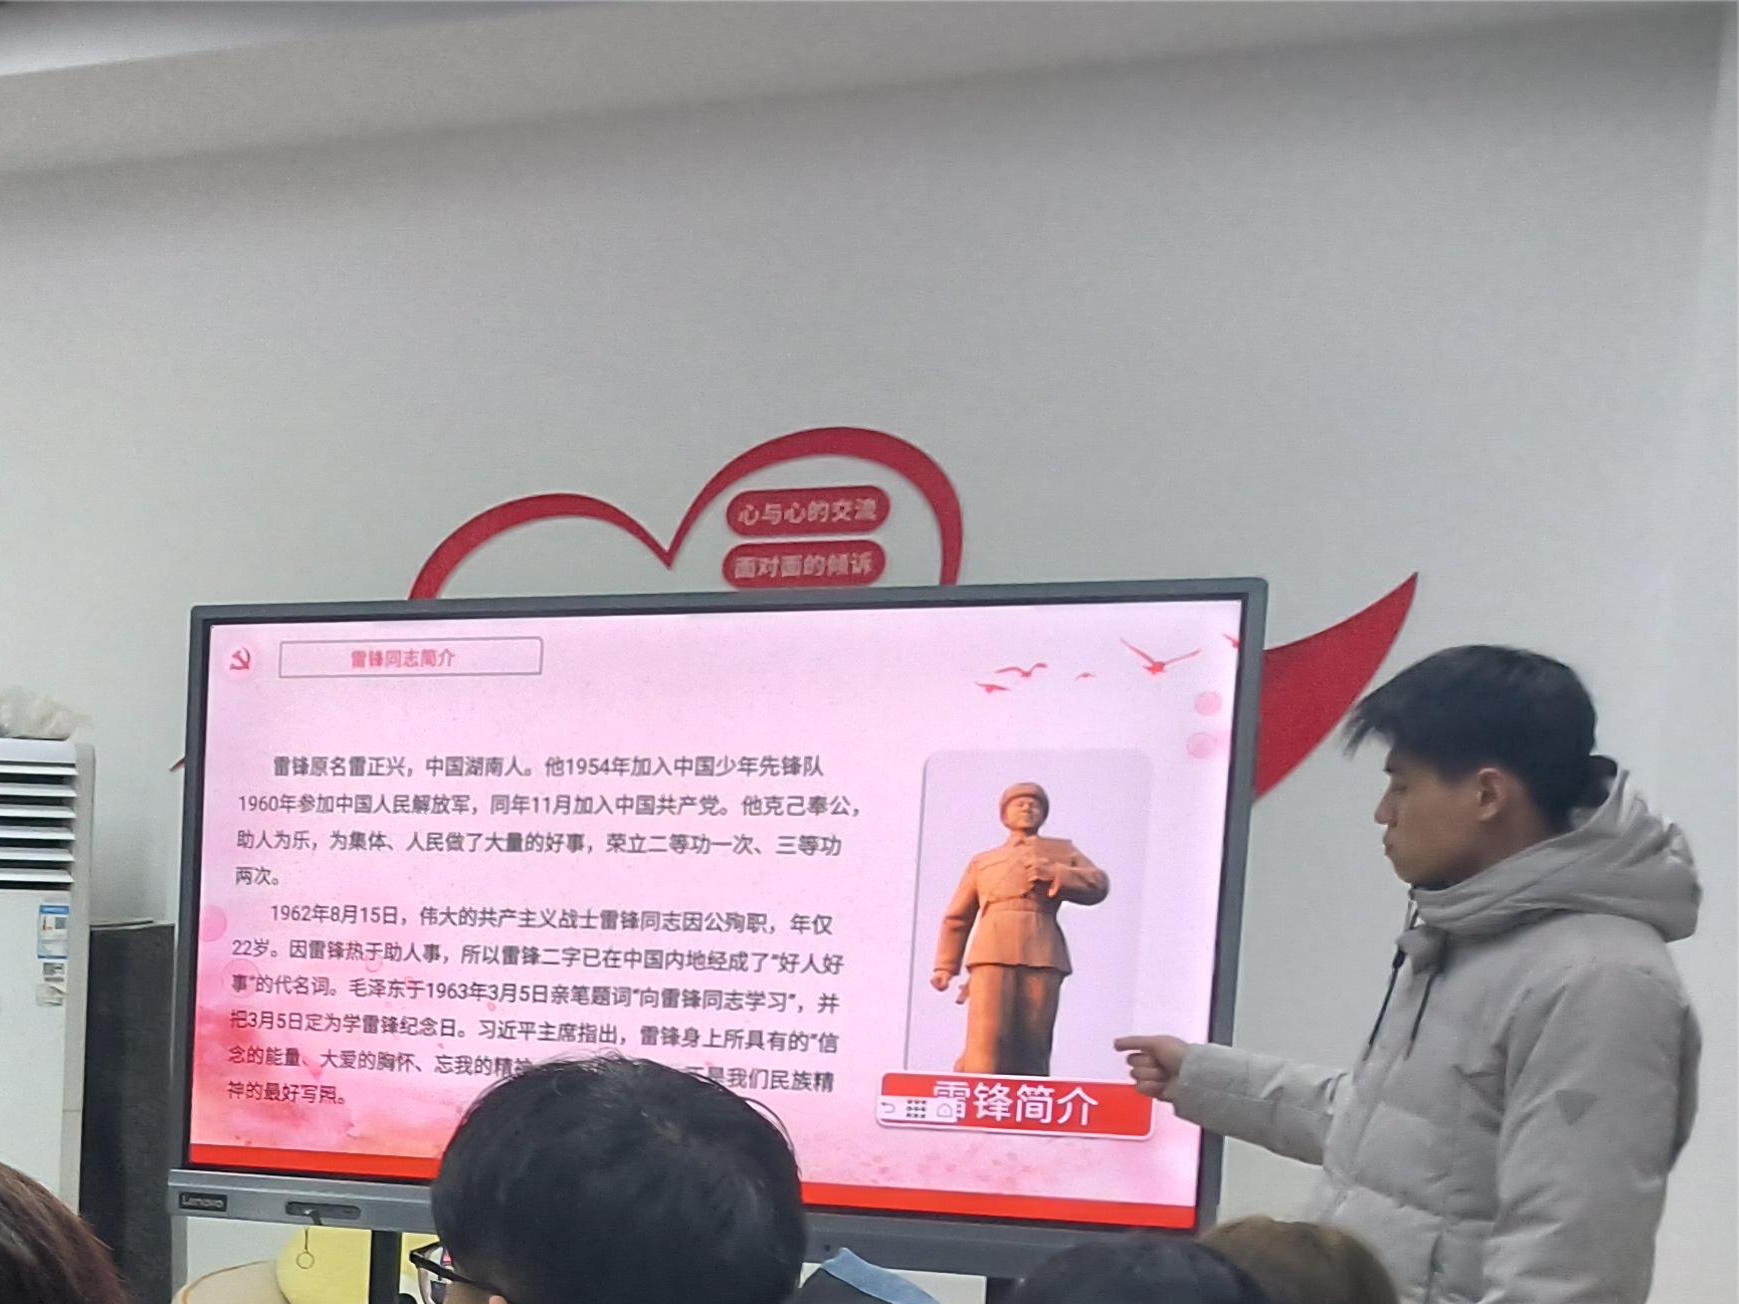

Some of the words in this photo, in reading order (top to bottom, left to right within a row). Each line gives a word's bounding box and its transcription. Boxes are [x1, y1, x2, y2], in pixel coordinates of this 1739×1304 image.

[737, 498, 878, 526] 心与心的交流
[734, 551, 873, 579] 面对面的倾诉
[350, 647, 456, 669] 雷锋同志简介
[234, 866, 279, 886] 两次。
[228, 1081, 346, 1105] 神的最好写照。
